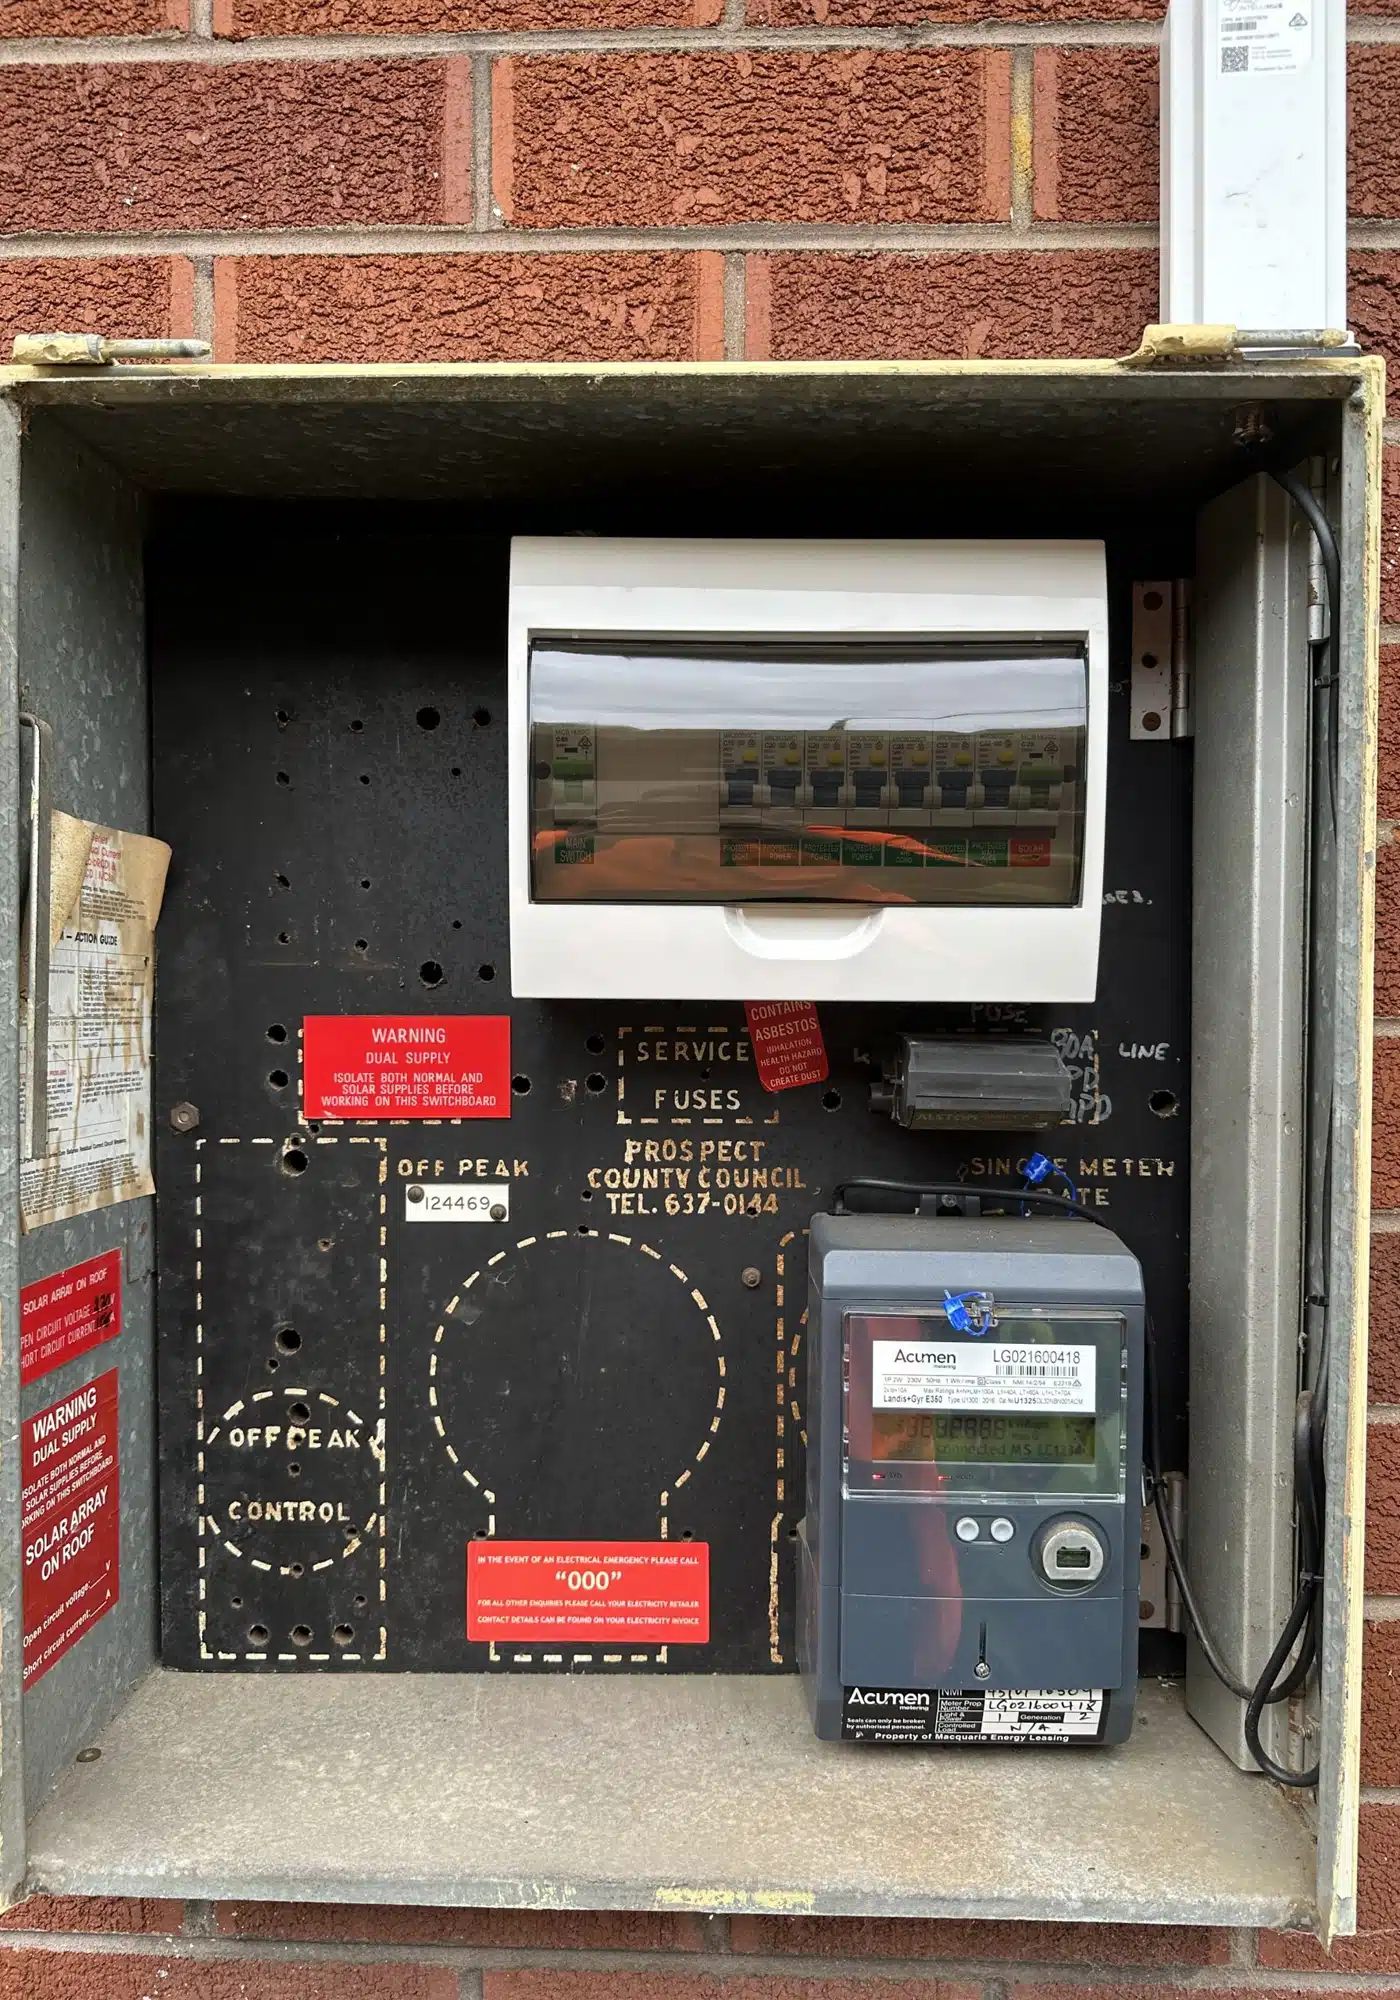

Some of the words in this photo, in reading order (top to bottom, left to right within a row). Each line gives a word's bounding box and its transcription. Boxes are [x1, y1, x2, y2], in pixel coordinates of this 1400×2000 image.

[560, 850, 592, 865] SWITCH
[769, 853, 792, 861] POWER
[811, 853, 832, 861] POWER
[851, 853, 874, 861] POWER
[74, 931, 98, 944] ACTION
[99, 934, 118, 947] GUIDE
[751, 1001, 812, 1021] CONTAINS
[371, 1027, 446, 1044] WARNING
[755, 1017, 818, 1042] ASBESTOS
[637, 1041, 750, 1061] SERVICE
[766, 1037, 813, 1054] INHALATION
[1118, 1041, 1171, 1061] LINE
[365, 1051, 398, 1064] DUAL
[405, 1051, 451, 1064] SUPPLY
[760, 1054, 790, 1067] HEALTH
[791, 1047, 822, 1061] HAZARD
[333, 1073, 375, 1083] ISOLATE
[381, 1073, 407, 1083] BOTH
[413, 1073, 456, 1083] NORMAL
[461, 1073, 483, 1083] AND
[779, 1065, 791, 1076] DO
[792, 1061, 808, 1073] NOT
[770, 1073, 801, 1088] CREATE
[800, 1069, 821, 1082] DUST
[342, 1084, 376, 1095] SOLAR
[380, 1084, 429, 1095] SUPPLIES
[435, 1084, 474, 1095] BEFORE
[321, 1096, 368, 1106] WORKING
[375, 1096, 390, 1106] ON
[395, 1096, 418, 1106] THIS
[422, 1096, 497, 1106] SWITCHBOARD
[655, 1089, 741, 1110] FUSES
[624, 1139, 766, 1164] PROSPECT
[397, 1158, 445, 1177] OFF
[459, 1158, 530, 1177] PEAK
[587, 1166, 691, 1189] COUNTY
[698, 1166, 807, 1189] COUNCIL
[425, 1196, 490, 1210] 124469
[606, 1192, 658, 1215] TEL.
[664, 1191, 779, 1216] 637-0144
[23, 1294, 49, 1315] SOLAR
[51, 1282, 73, 1303] ARRAY
[76, 1278, 87, 1291] ON
[89, 1268, 107, 1284] ROOF
[20, 1331, 34, 1349] PEN
[36, 1318, 62, 1342] CIRCUIT
[64, 1304, 91, 1327] VOLTAGE
[21, 1349, 38, 1368] HORT
[41, 1335, 65, 1358] CIRCUIT
[68, 1320, 96, 1345] CURRENT
[894, 1349, 957, 1364] Acumen
[993, 1349, 1081, 1365] LG021600418
[884, 1394, 923, 1405] Landis+Gyr
[33, 1387, 97, 1443] WARNING
[33, 1438, 60, 1467] DUAL
[62, 1413, 97, 1447] SUPPLY
[229, 1426, 281, 1449] OFF
[287, 1426, 360, 1450] PEAK
[22, 1477, 49, 1500] ISOLATE
[50, 1464, 68, 1480] BOTH
[68, 1447, 93, 1468] NORMAL
[94, 1434, 107, 1449] AND
[26, 1489, 48, 1511] SOLAR
[50, 1467, 79, 1495] SUPPLIES
[80, 1450, 103, 1472] BEFORE
[22, 1505, 44, 1529] ORKING
[46, 1498, 56, 1511] ON
[57, 1485, 70, 1502] THIS
[72, 1455, 113, 1491] SWITCHBOARD
[228, 1501, 350, 1523] CONTROL
[26, 1522, 68, 1566] SOLAR
[70, 1485, 108, 1531] ARRAY
[41, 1551, 60, 1581] ON
[62, 1523, 96, 1566] ROOF
[477, 1555, 486, 1564] IN
[487, 1555, 503, 1564] THE
[504, 1555, 529, 1564] EVENT
[531, 1555, 542, 1564] OF
[543, 1555, 554, 1564] AN
[556, 1556, 602, 1565] ELECTRICAL
[603, 1556, 648, 1565] EMERGENCY
[651, 1556, 678, 1565] PLEASE
[680, 1556, 699, 1565] CALL
[23, 1626, 42, 1648] Open
[43, 1603, 65, 1628] circuit
[105, 1560, 111, 1571] V
[477, 1599, 491, 1607] FOR
[492, 1599, 505, 1607] ALL
[506, 1599, 528, 1607] OTHER
[529, 1599, 563, 1608] ENQUIRIES
[564, 1599, 589, 1608] PLEASE
[590, 1600, 606, 1608] CALL
[608, 1600, 626, 1608] YOUR
[627, 1600, 668, 1608] ELECTRICITY
[669, 1600, 699, 1608] RETAILER
[477, 1615, 510, 1624] CONTACT
[511, 1615, 539, 1624] DETAILS
[540, 1615, 555, 1624] CAN
[556, 1615, 566, 1624] BE
[567, 1616, 592, 1624] FOUND
[593, 1616, 604, 1624] ON
[605, 1616, 625, 1625] YOUR
[626, 1616, 670, 1625] ELECTRICITY
[671, 1616, 700, 1625] INVOICE
[23, 1656, 43, 1680] Short
[43, 1632, 65, 1659] circuit
[105, 1588, 111, 1600] A
[847, 1687, 930, 1705] Acumen
[941, 1689, 963, 1697] NMI
[963, 1700, 982, 1708] Prop
[1079, 1712, 1092, 1720] 2
[875, 1732, 919, 1741] Property
[921, 1732, 932, 1740] of
[935, 1733, 987, 1742] Macquarie
[990, 1733, 1025, 1743] Energy
[1029, 1734, 1070, 1743] Leasing
